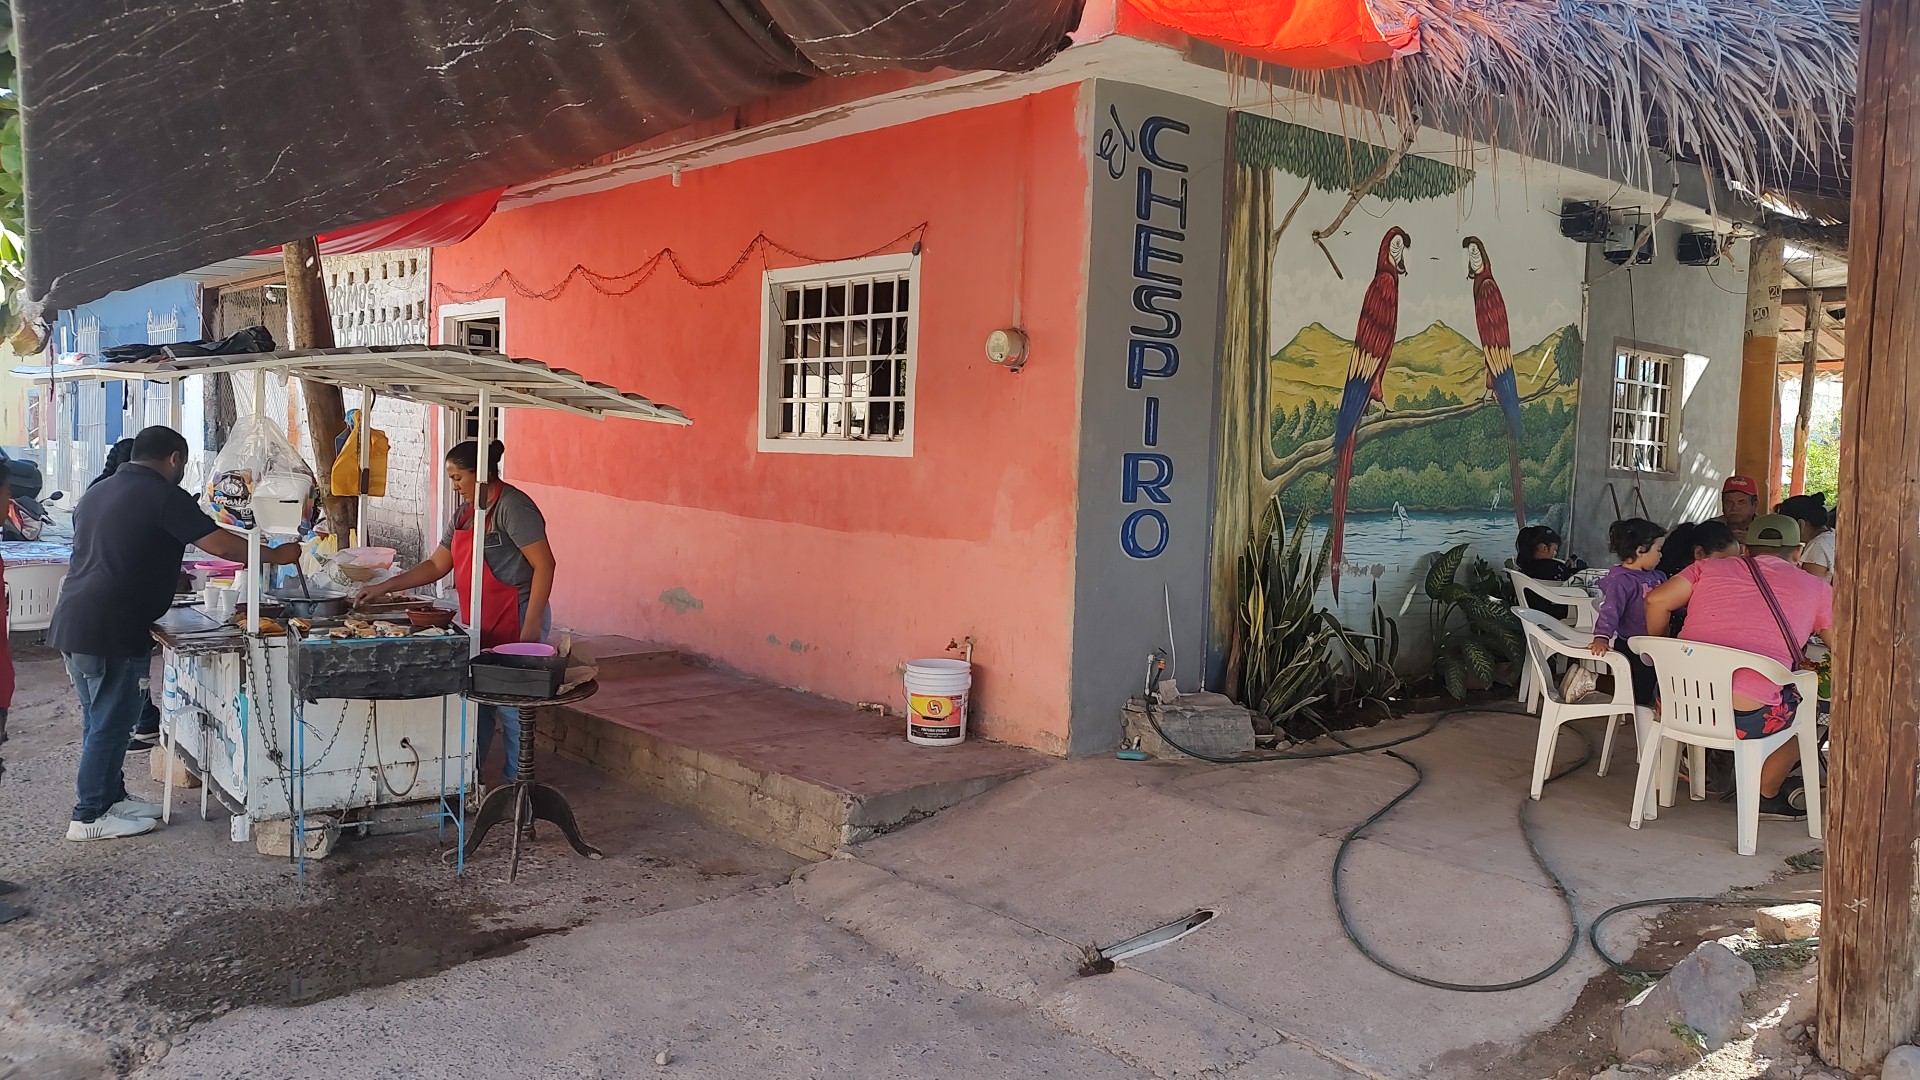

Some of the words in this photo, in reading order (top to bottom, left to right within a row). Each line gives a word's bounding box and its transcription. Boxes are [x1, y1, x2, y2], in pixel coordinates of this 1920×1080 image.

[1769, 285, 1781, 297] 20
[1753, 307, 1768, 320] 20
[1118, 115, 1190, 559] CHESPIRO
